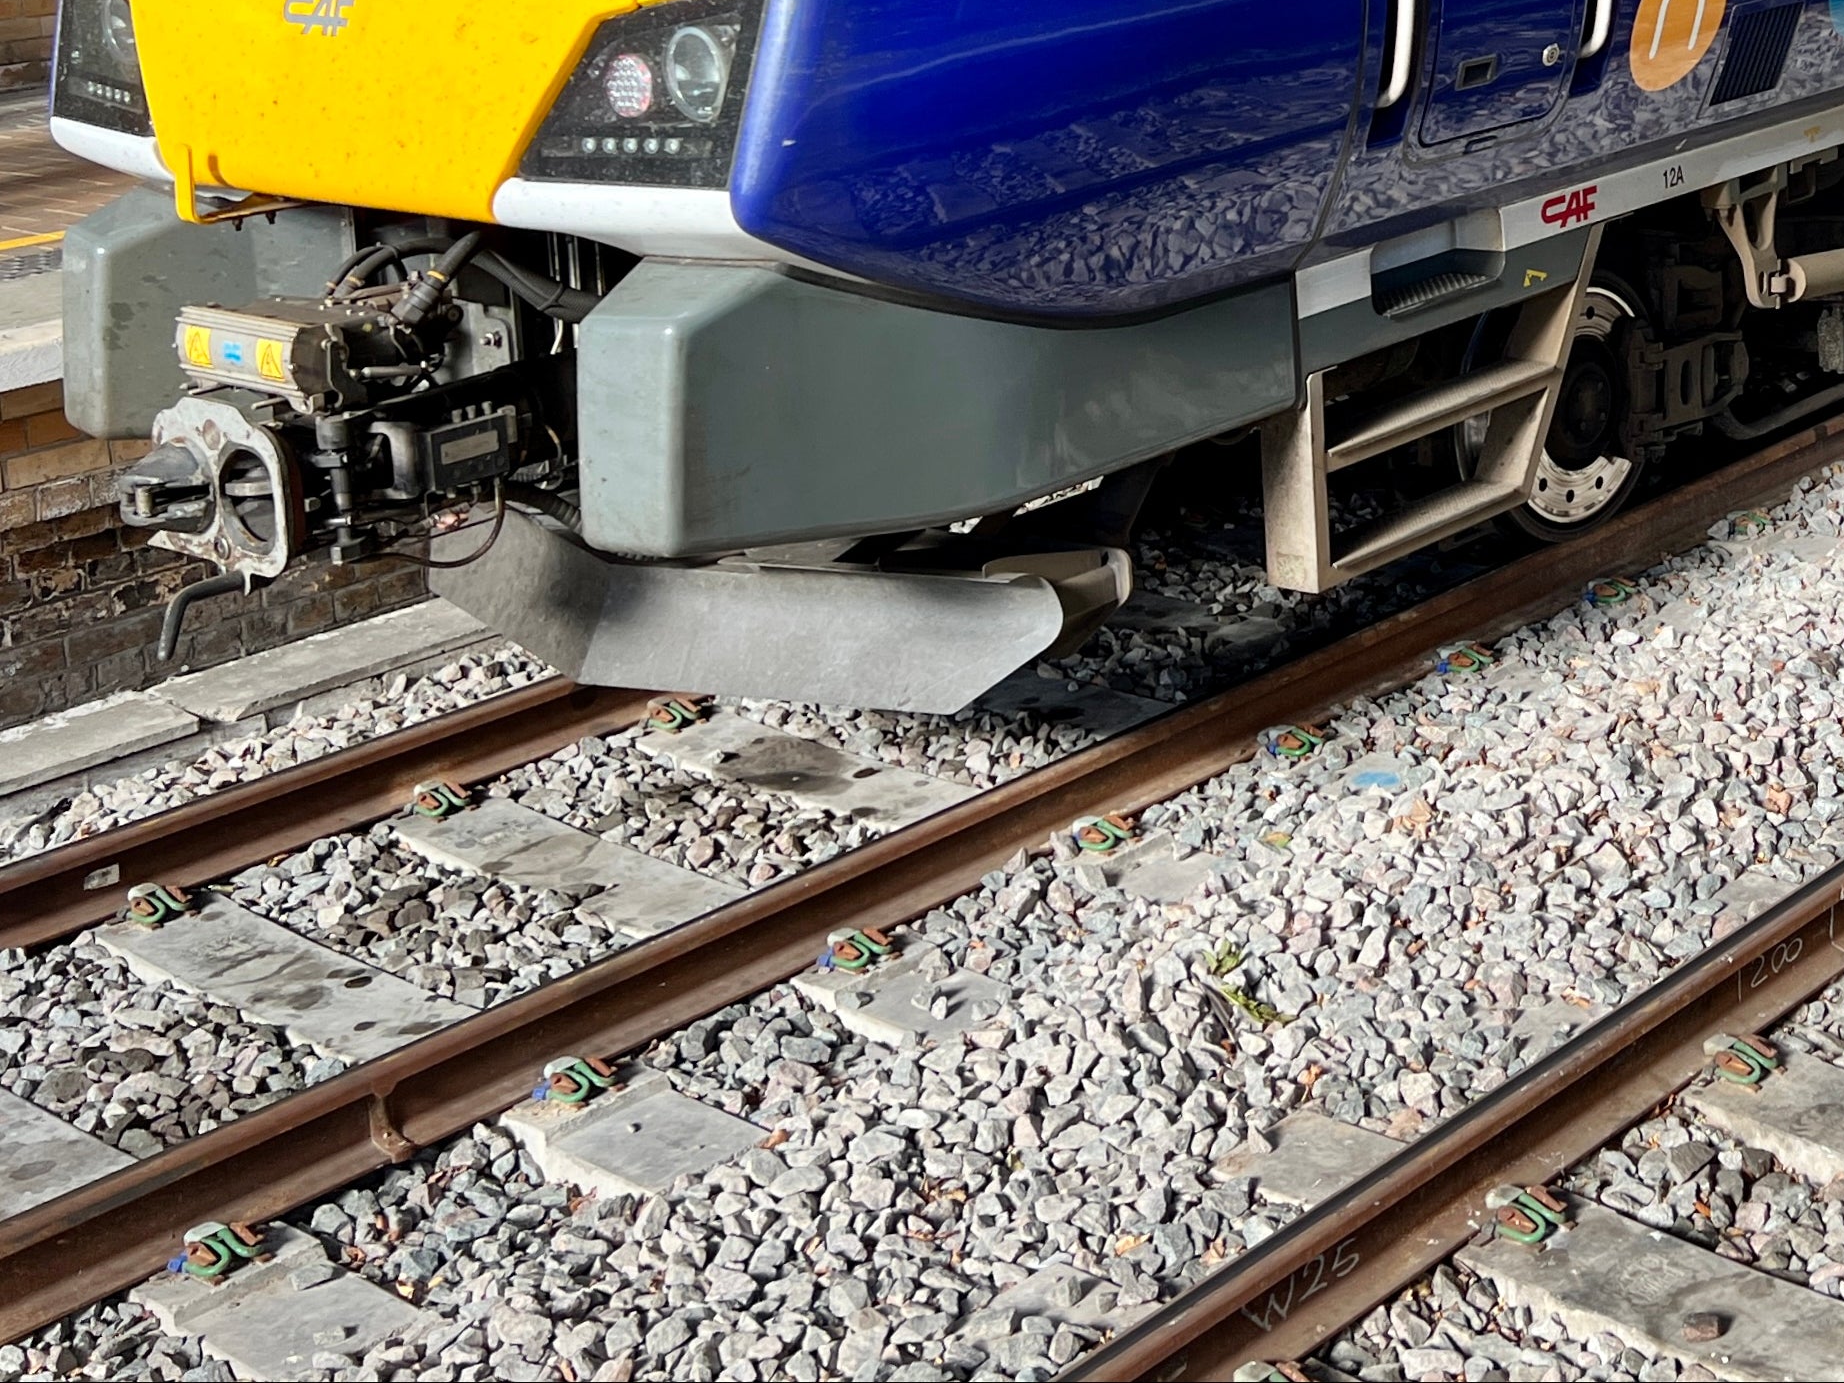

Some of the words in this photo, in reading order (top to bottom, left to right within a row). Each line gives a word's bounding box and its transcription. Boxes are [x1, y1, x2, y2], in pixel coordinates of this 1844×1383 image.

[1663, 165, 1685, 189] 12A
[1541, 184, 1598, 229] CAF
[1240, 1237, 1360, 1333] W25
